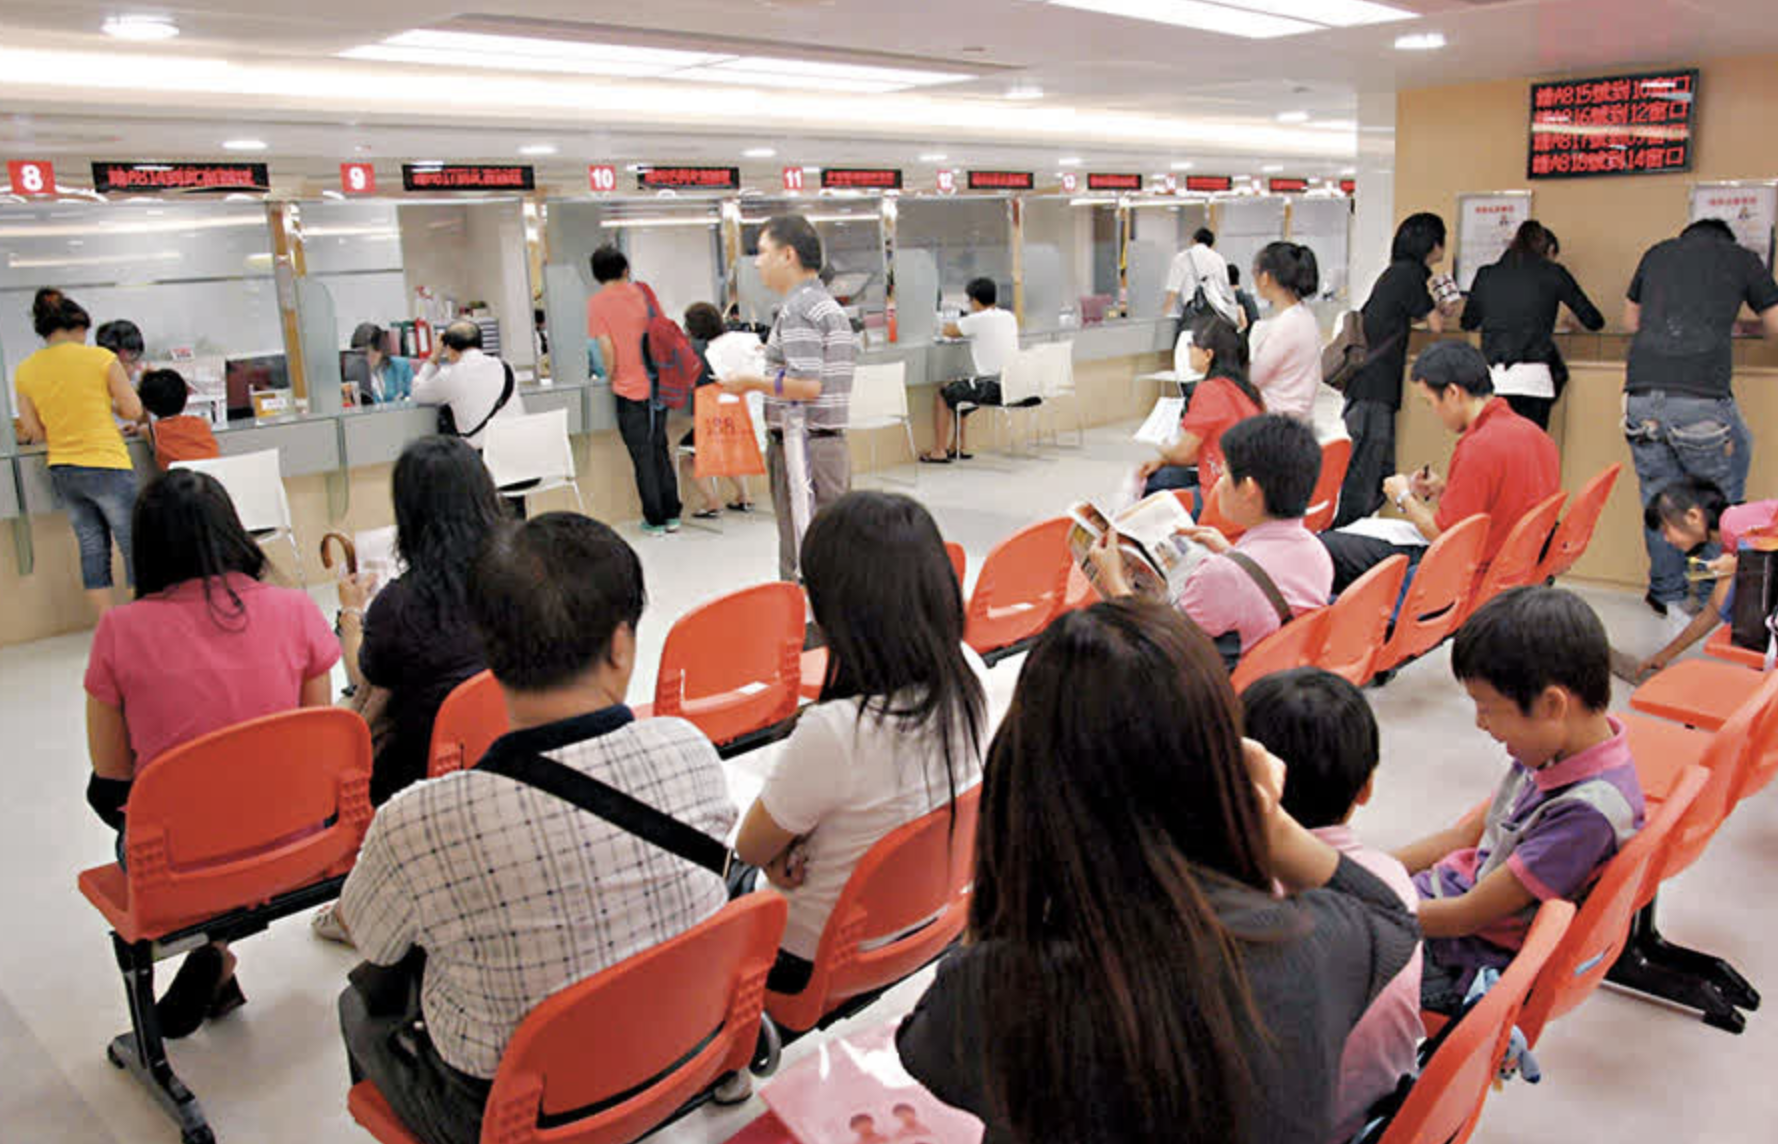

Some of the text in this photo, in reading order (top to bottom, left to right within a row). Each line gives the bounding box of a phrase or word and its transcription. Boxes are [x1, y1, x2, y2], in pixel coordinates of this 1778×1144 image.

[21, 164, 44, 192] 8
[350, 166, 366, 190] 9
[592, 169, 613, 188] 10
[786, 169, 802, 188] 11
